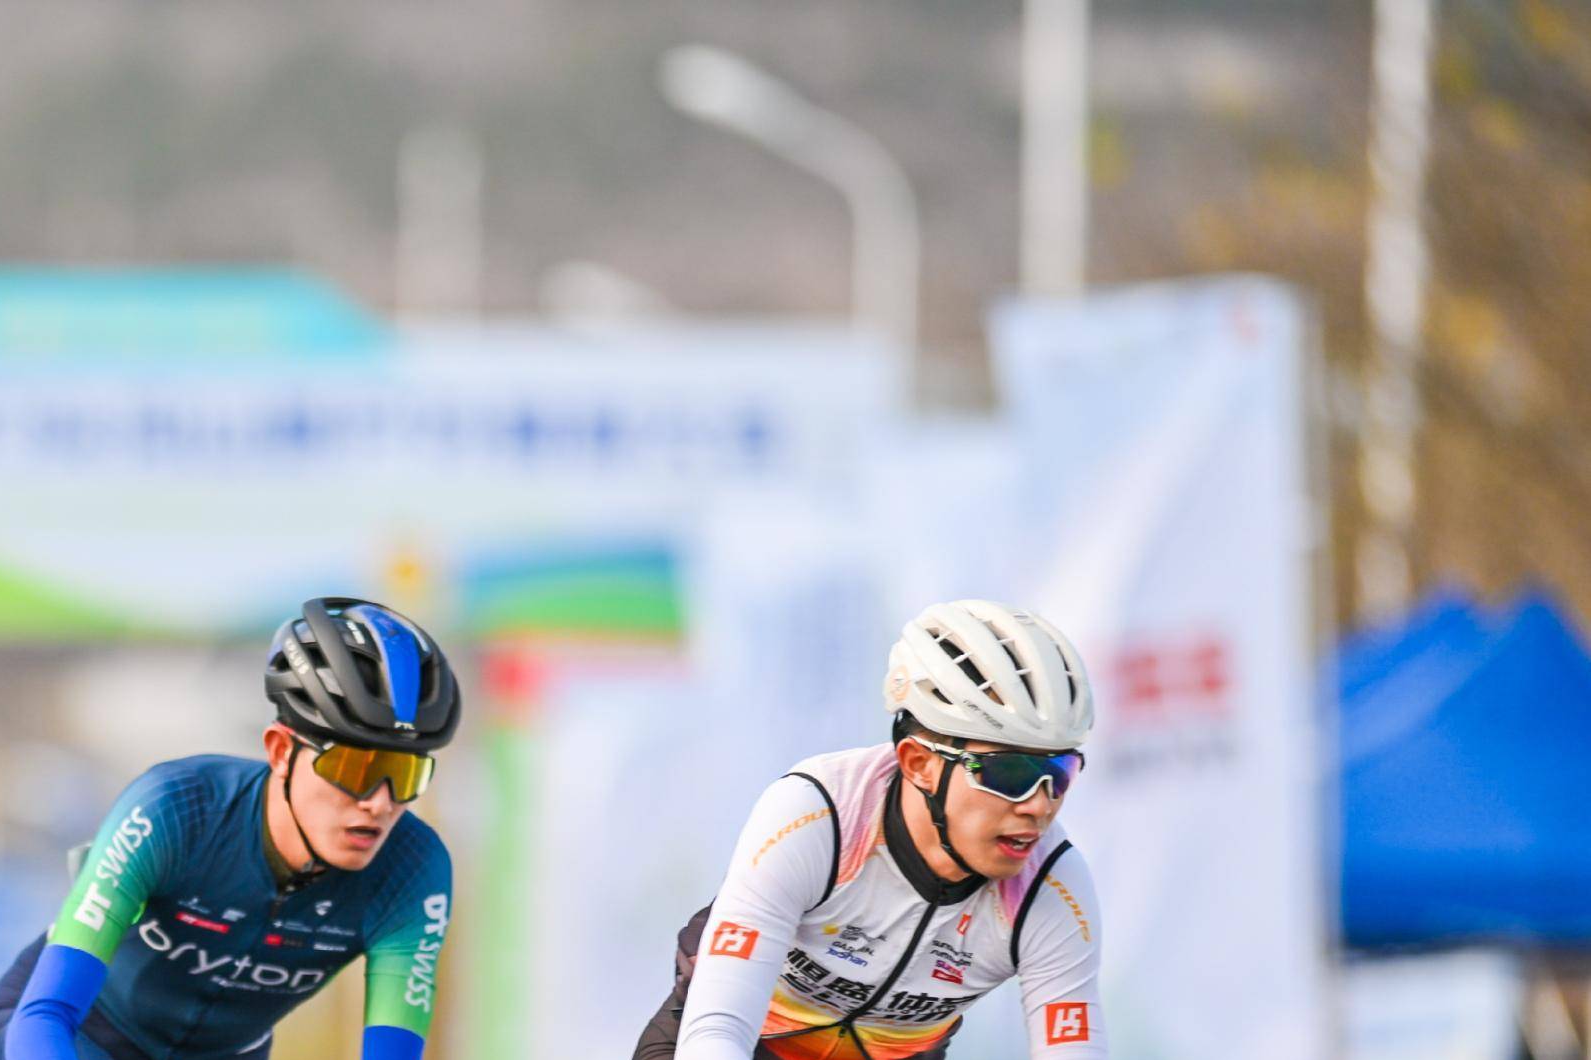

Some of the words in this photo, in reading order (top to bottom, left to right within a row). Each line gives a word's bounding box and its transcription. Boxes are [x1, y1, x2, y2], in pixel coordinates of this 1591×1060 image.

[73, 895, 112, 931] DT
[95, 806, 153, 889] SWISS
[138, 919, 325, 993] bryton
[405, 939, 440, 1013] SWISS
